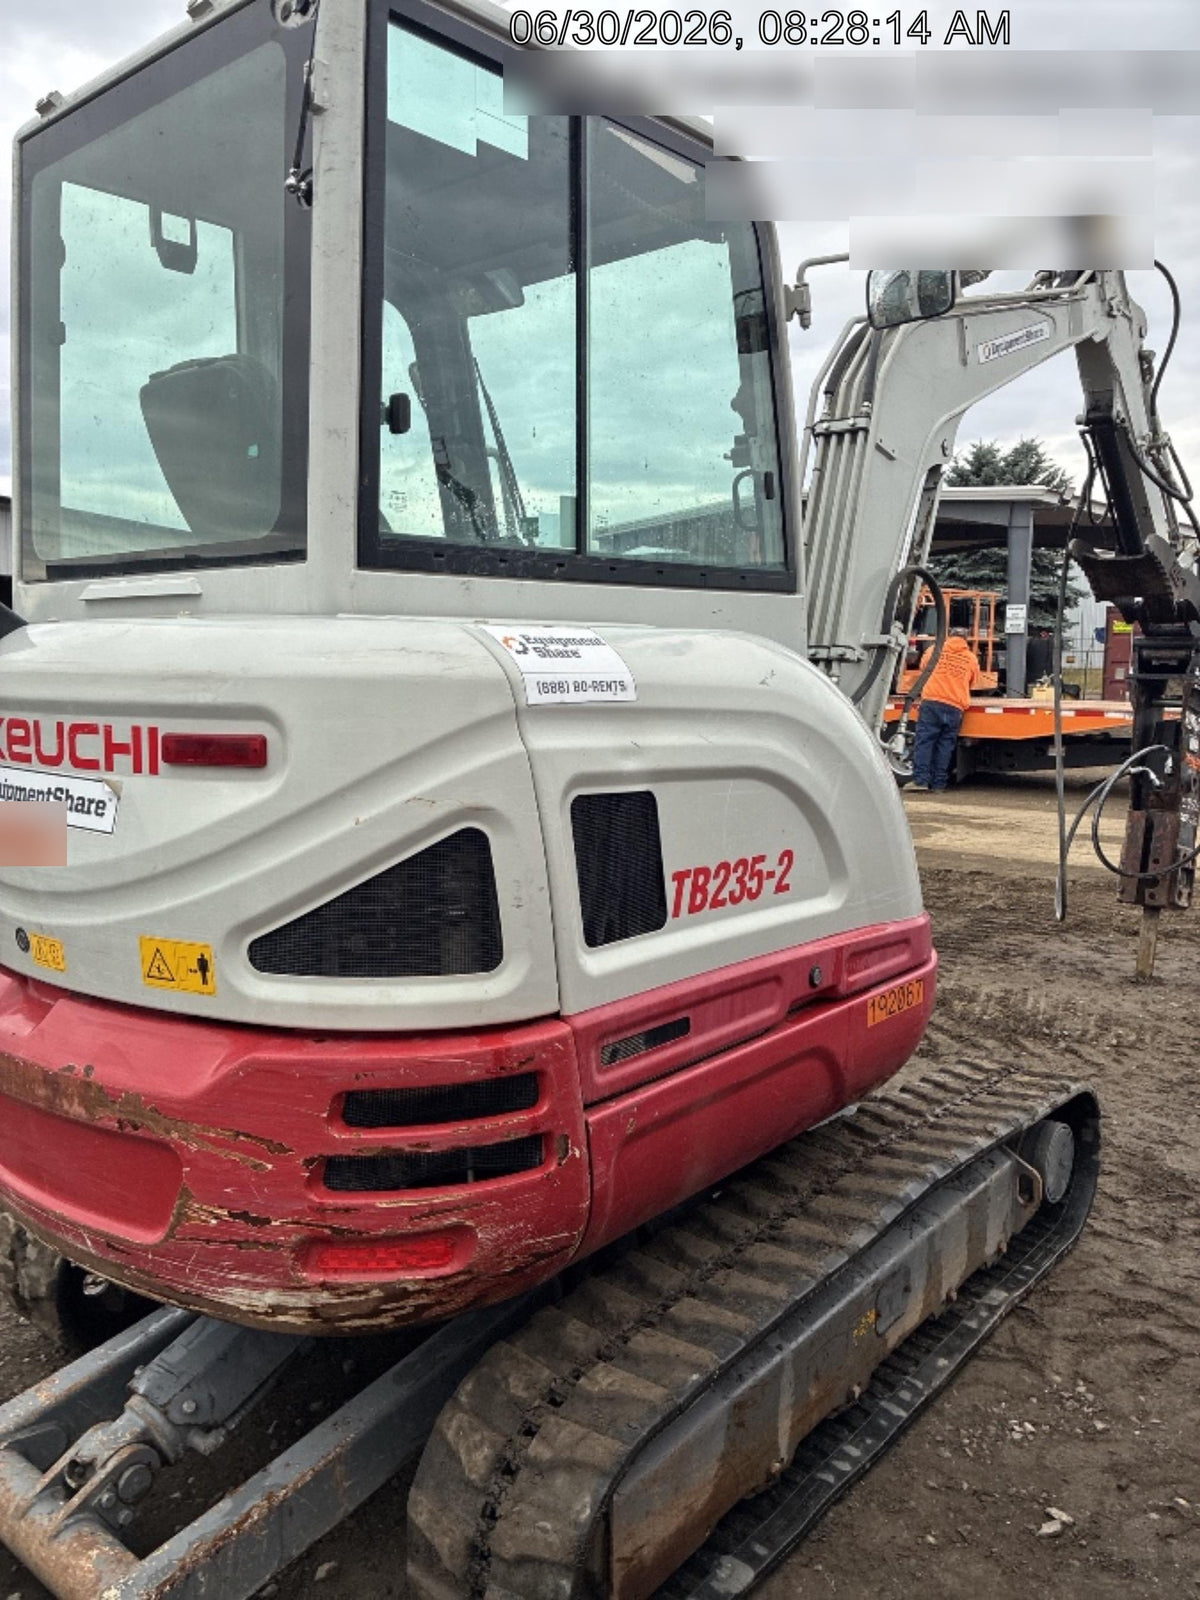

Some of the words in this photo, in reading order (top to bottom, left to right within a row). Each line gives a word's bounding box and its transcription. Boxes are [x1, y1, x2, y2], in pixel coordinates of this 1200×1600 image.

[519, 634, 607, 648] Equipment
[532, 646, 582, 659] Share
[671, 849, 794, 919] TB235-2
